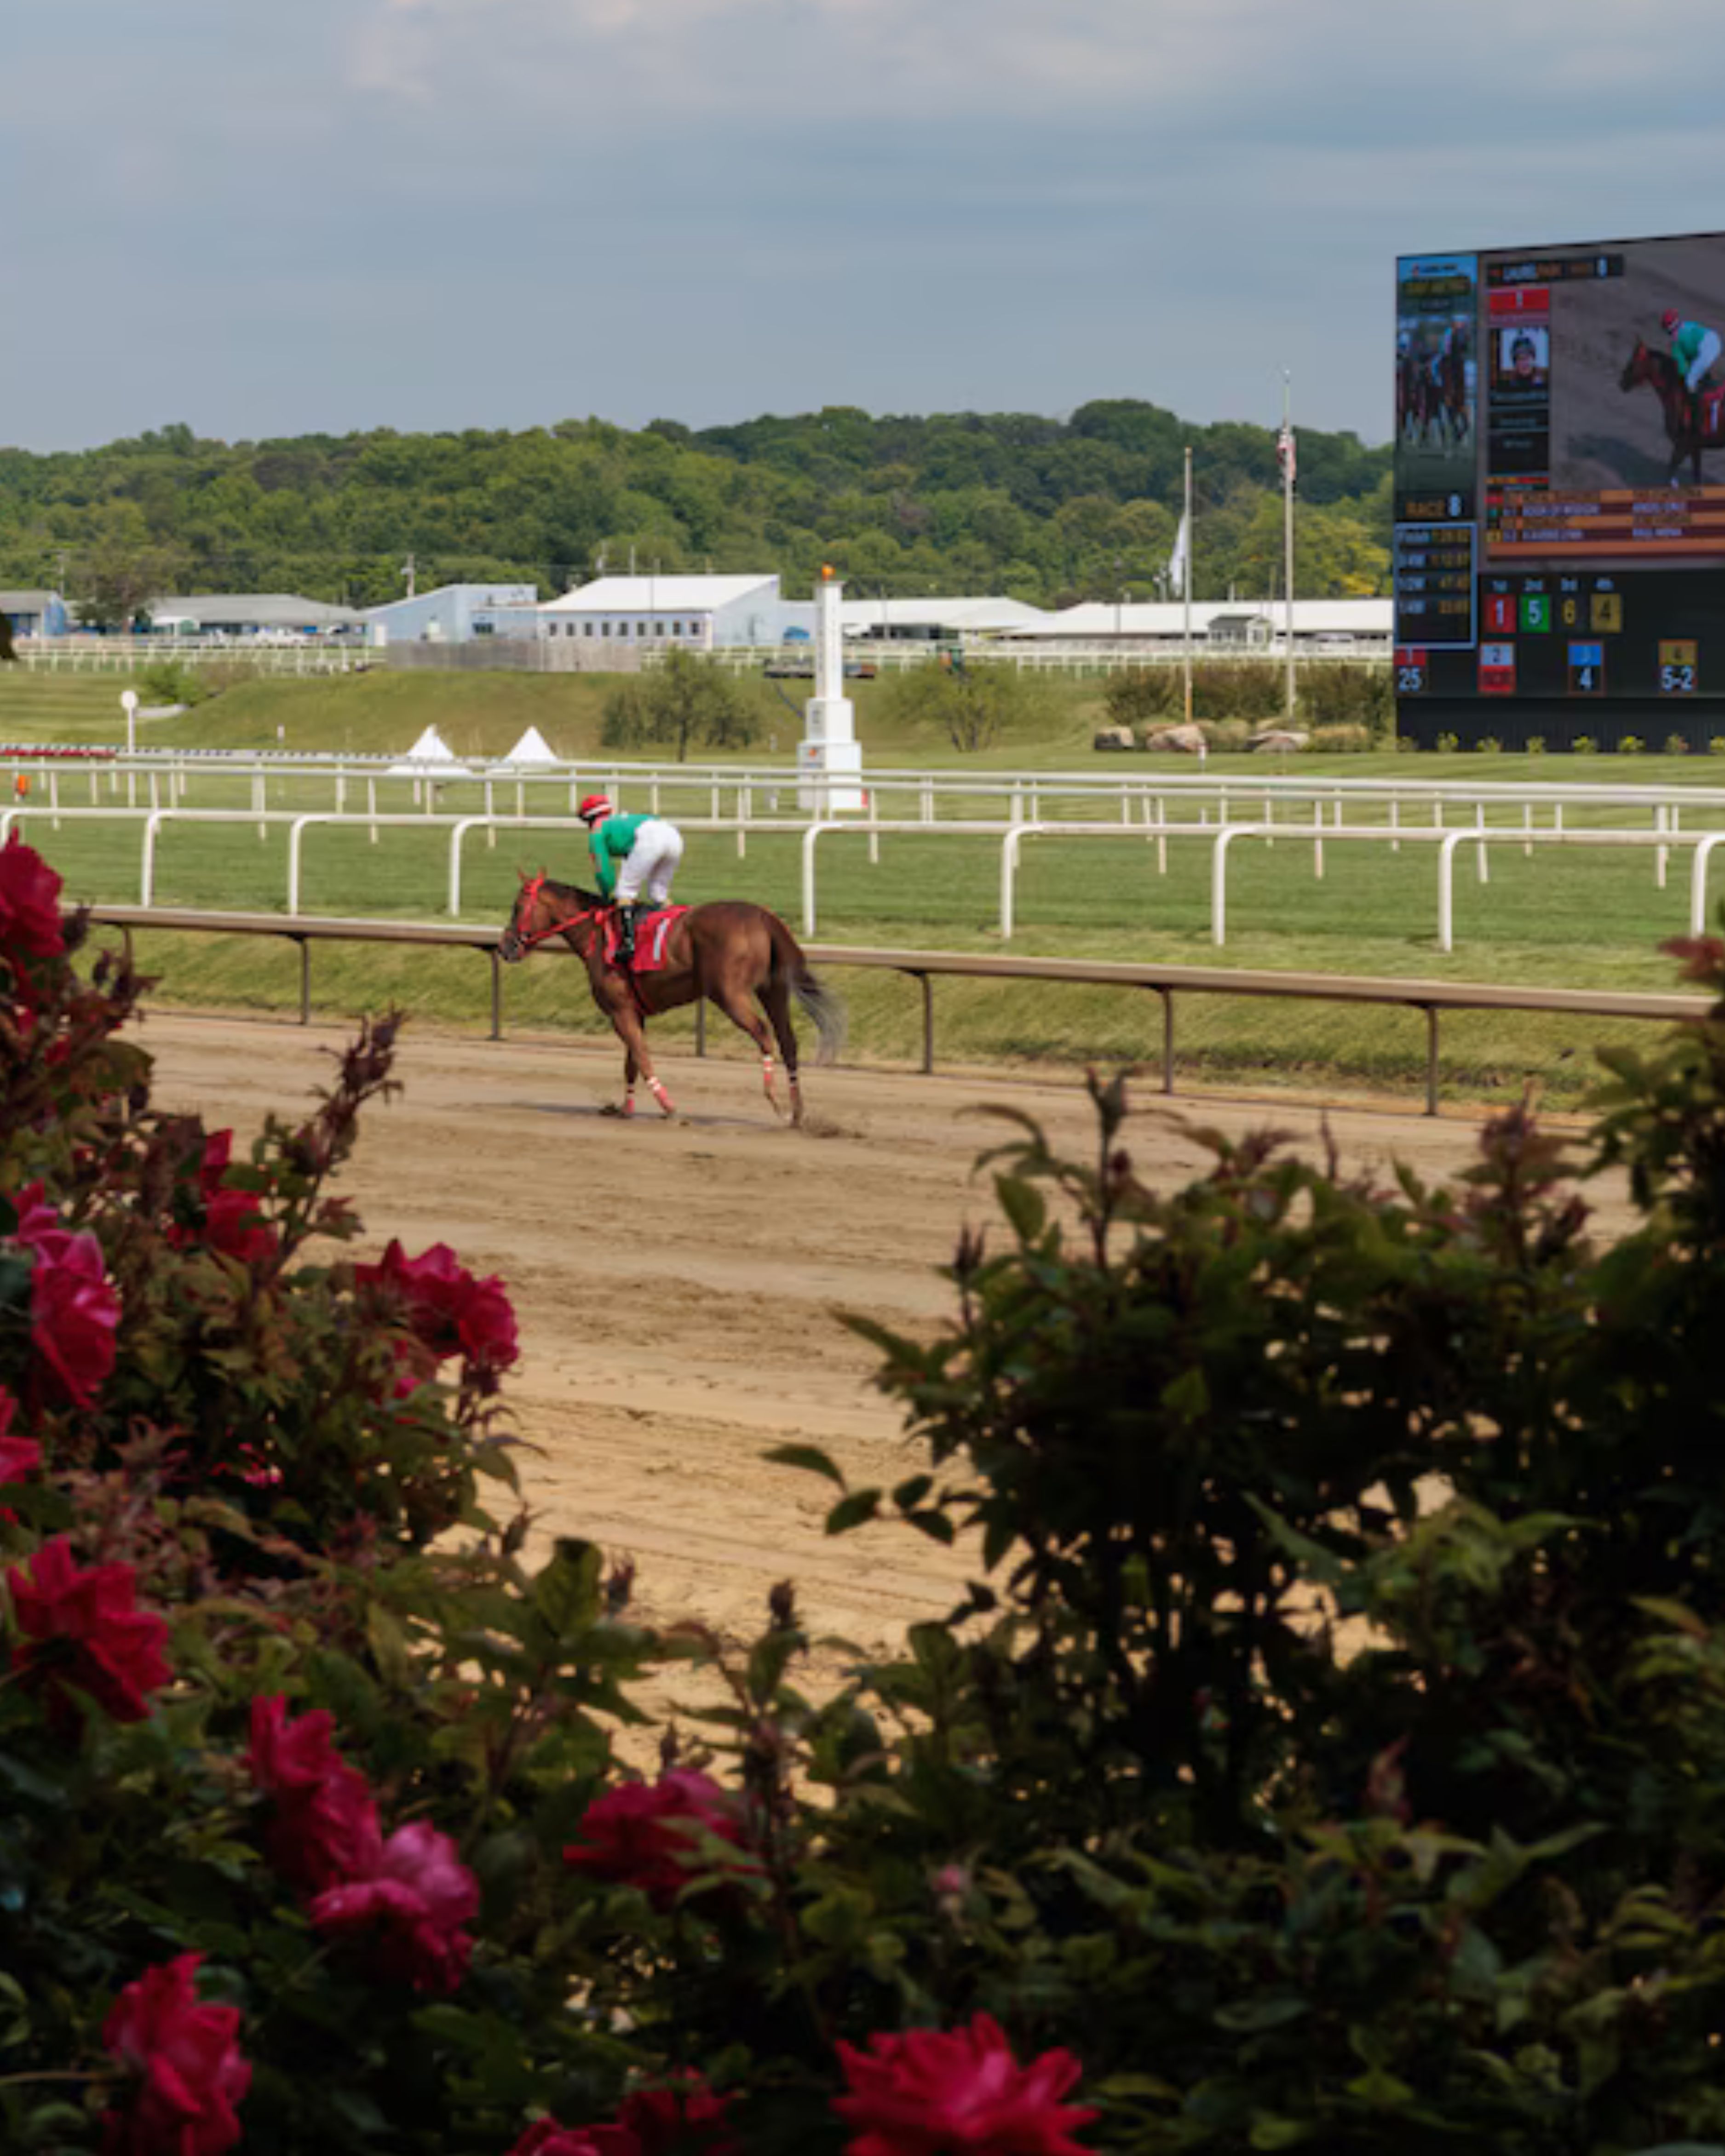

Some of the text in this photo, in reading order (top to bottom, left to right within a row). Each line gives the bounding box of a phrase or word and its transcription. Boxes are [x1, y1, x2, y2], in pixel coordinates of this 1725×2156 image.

[1496, 599, 1504, 625] 1
[1528, 599, 1541, 625] 5
[1563, 599, 1576, 624] 6
[1599, 599, 1612, 620] 4
[1492, 646, 1501, 663] 2
[1398, 665, 1693, 691] 25 4 5-2
[654, 918, 671, 962] 1
